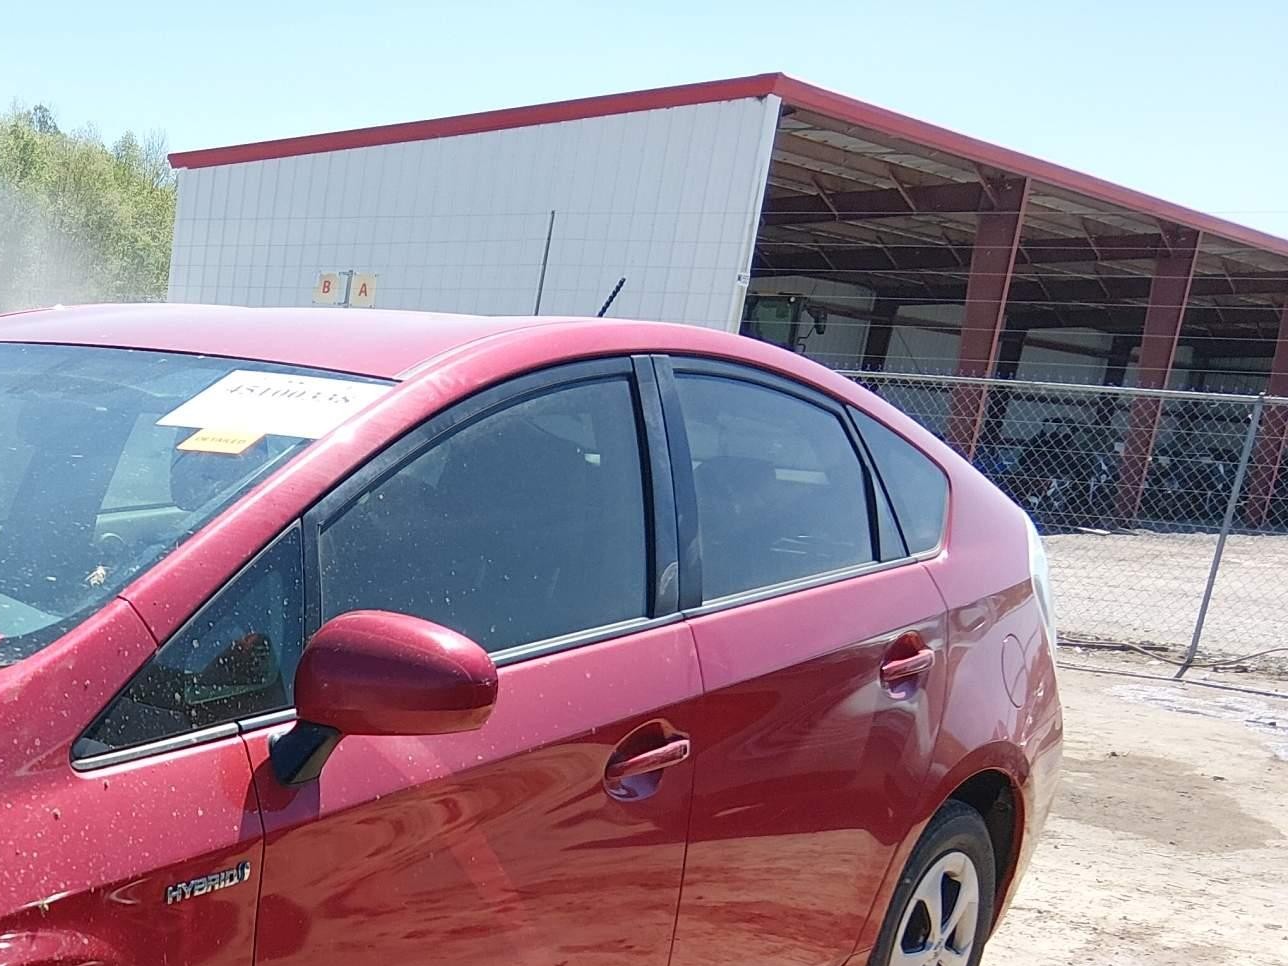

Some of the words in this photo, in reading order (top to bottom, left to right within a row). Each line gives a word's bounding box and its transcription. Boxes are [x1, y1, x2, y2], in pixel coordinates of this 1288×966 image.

[322, 280, 331, 294] B
[358, 283, 368, 297] A
[166, 868, 240, 905] HYBRID
